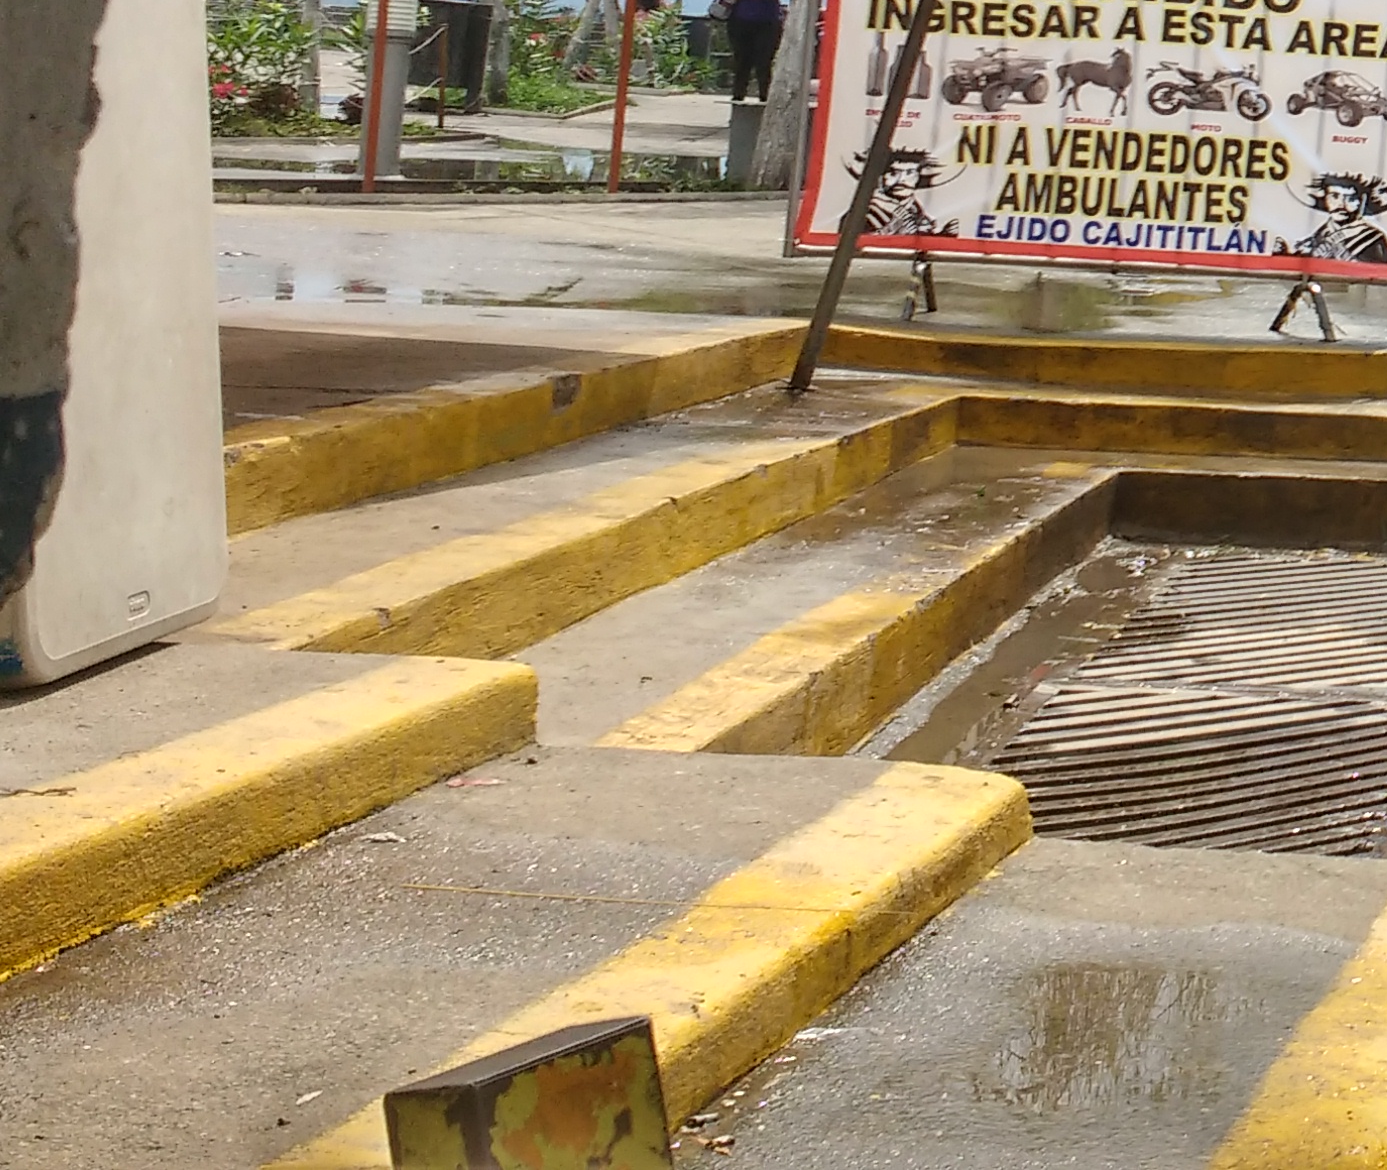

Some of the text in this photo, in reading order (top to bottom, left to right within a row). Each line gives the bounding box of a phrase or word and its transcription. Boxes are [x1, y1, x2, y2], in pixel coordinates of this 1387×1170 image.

[1115, 7, 1146, 42] A
[1175, 7, 1272, 52] ESTA
[1065, 116, 1112, 126] CABALLO
[1191, 123, 1222, 133] MOTO
[1332, 135, 1369, 145] BUGGY
[957, 125, 1289, 180] NI A VENDEDORES
[995, 172, 1249, 224] AMBULANTES
[975, 212, 1268, 255] EJIDO CAJITITLÁN
